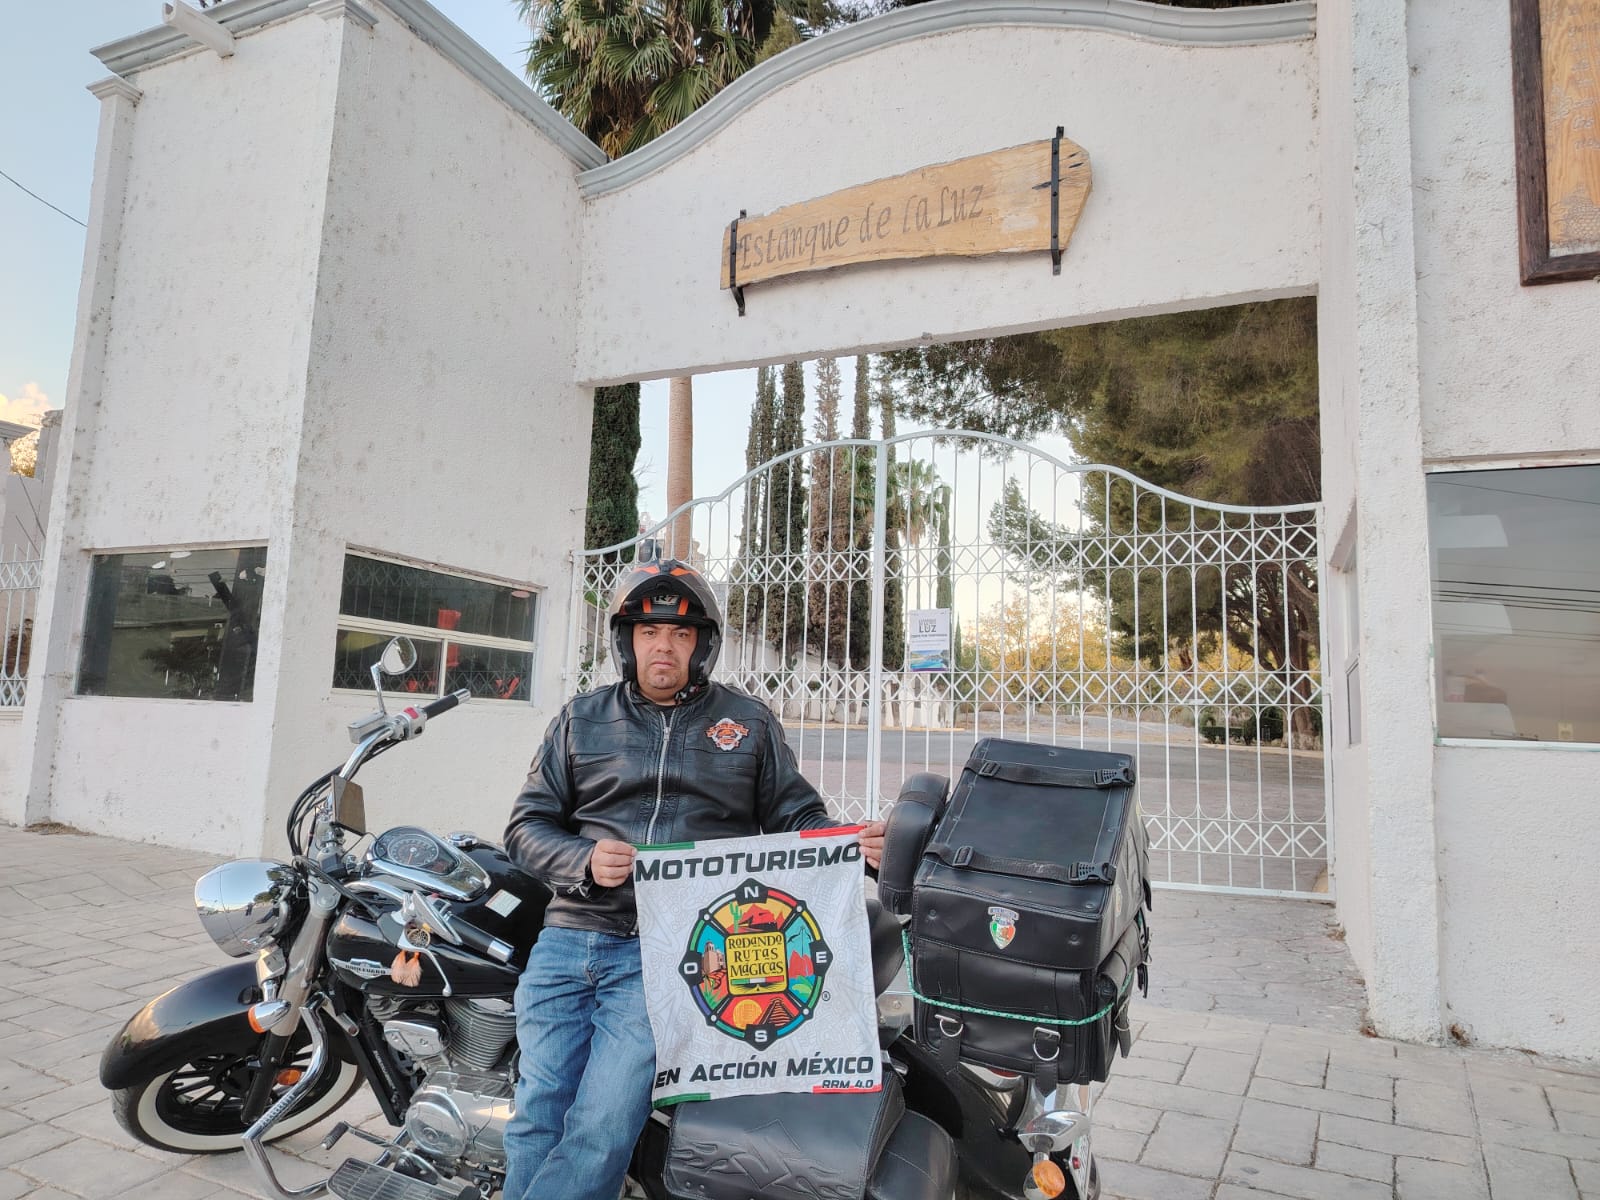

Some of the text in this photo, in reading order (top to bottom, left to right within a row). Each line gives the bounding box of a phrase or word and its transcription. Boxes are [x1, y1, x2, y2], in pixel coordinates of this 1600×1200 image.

[739, 215, 850, 270] Estanque
[859, 201, 891, 243] de
[937, 184, 984, 227] Luz
[918, 624, 937, 633] LUZ
[634, 841, 862, 882] MOTOTURISMO
[743, 886, 759, 898] N
[815, 952, 827, 963] E
[683, 962, 698, 974] O
[754, 1029, 768, 1042] S
[654, 1051, 874, 1089] EN ACCIÓN MÉXICO
[822, 1079, 874, 1089] RRM 4.0
